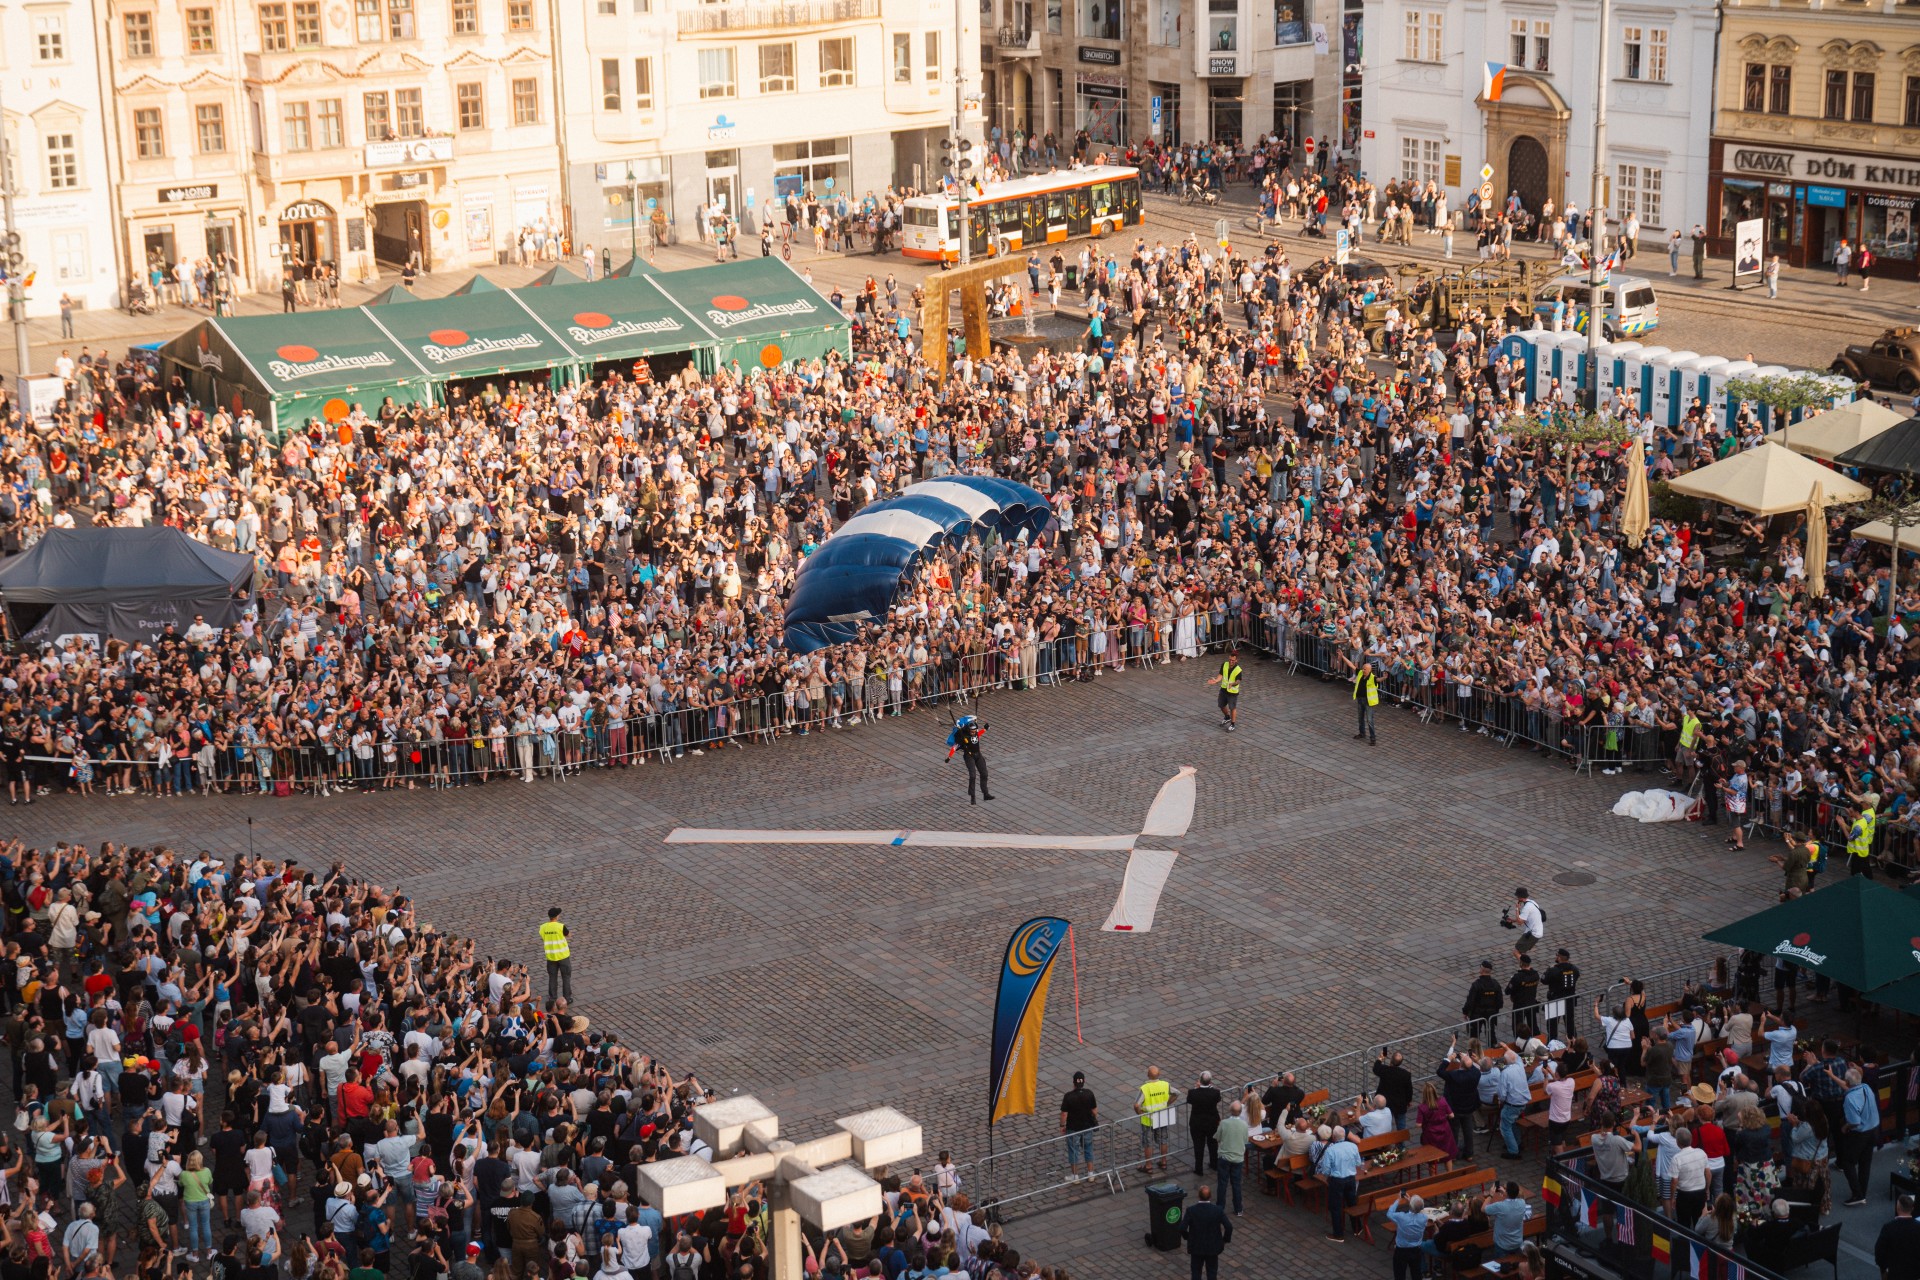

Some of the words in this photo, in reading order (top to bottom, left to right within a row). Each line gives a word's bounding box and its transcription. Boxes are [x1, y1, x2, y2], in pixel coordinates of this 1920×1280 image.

[1153, 109, 1160, 120] P
[1740, 152, 1787, 171] NAVA
[1806, 157, 1856, 180] DŮM
[184, 186, 212, 199] LOTUS
[706, 308, 762, 328] Pilsner
[754, 299, 813, 316] Urquell
[567, 326, 625, 346] Pilsner
[618, 317, 679, 333] Urquell
[421, 344, 481, 364] Pilsner
[474, 333, 538, 350] Urquell
[268, 360, 331, 381] Pilsner
[324, 352, 391, 369] Urquell
[1554, 1256, 1572, 1271] KOMA
